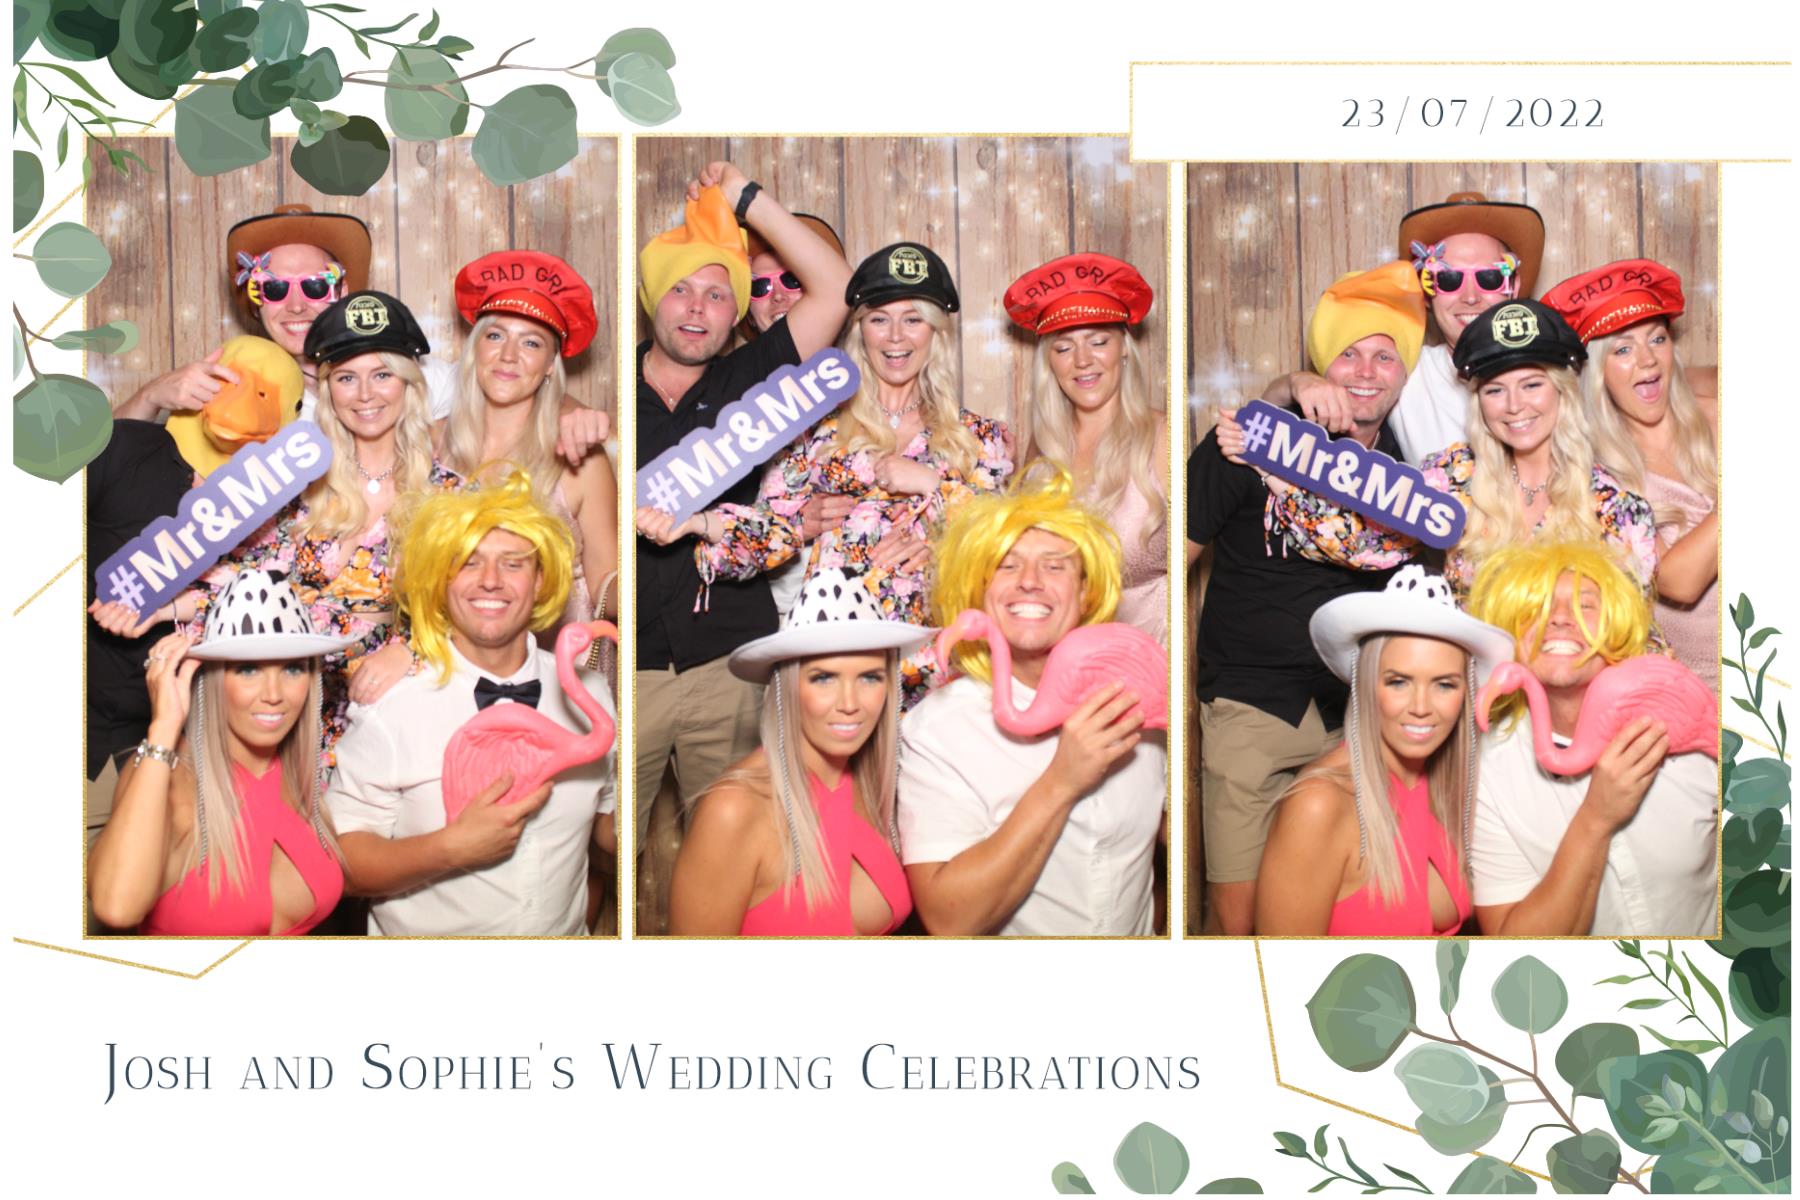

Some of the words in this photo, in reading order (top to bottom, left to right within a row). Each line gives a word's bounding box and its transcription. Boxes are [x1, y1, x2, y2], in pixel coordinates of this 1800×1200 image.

[888, 256, 929, 277] FBI
[345, 306, 390, 329] FBI
[1491, 315, 1540, 342] FBI
[646, 357, 850, 515] #Mr&Mrs
[1243, 411, 1456, 538] #Mr&Mrs
[109, 431, 321, 614] #Mr&Mrs
